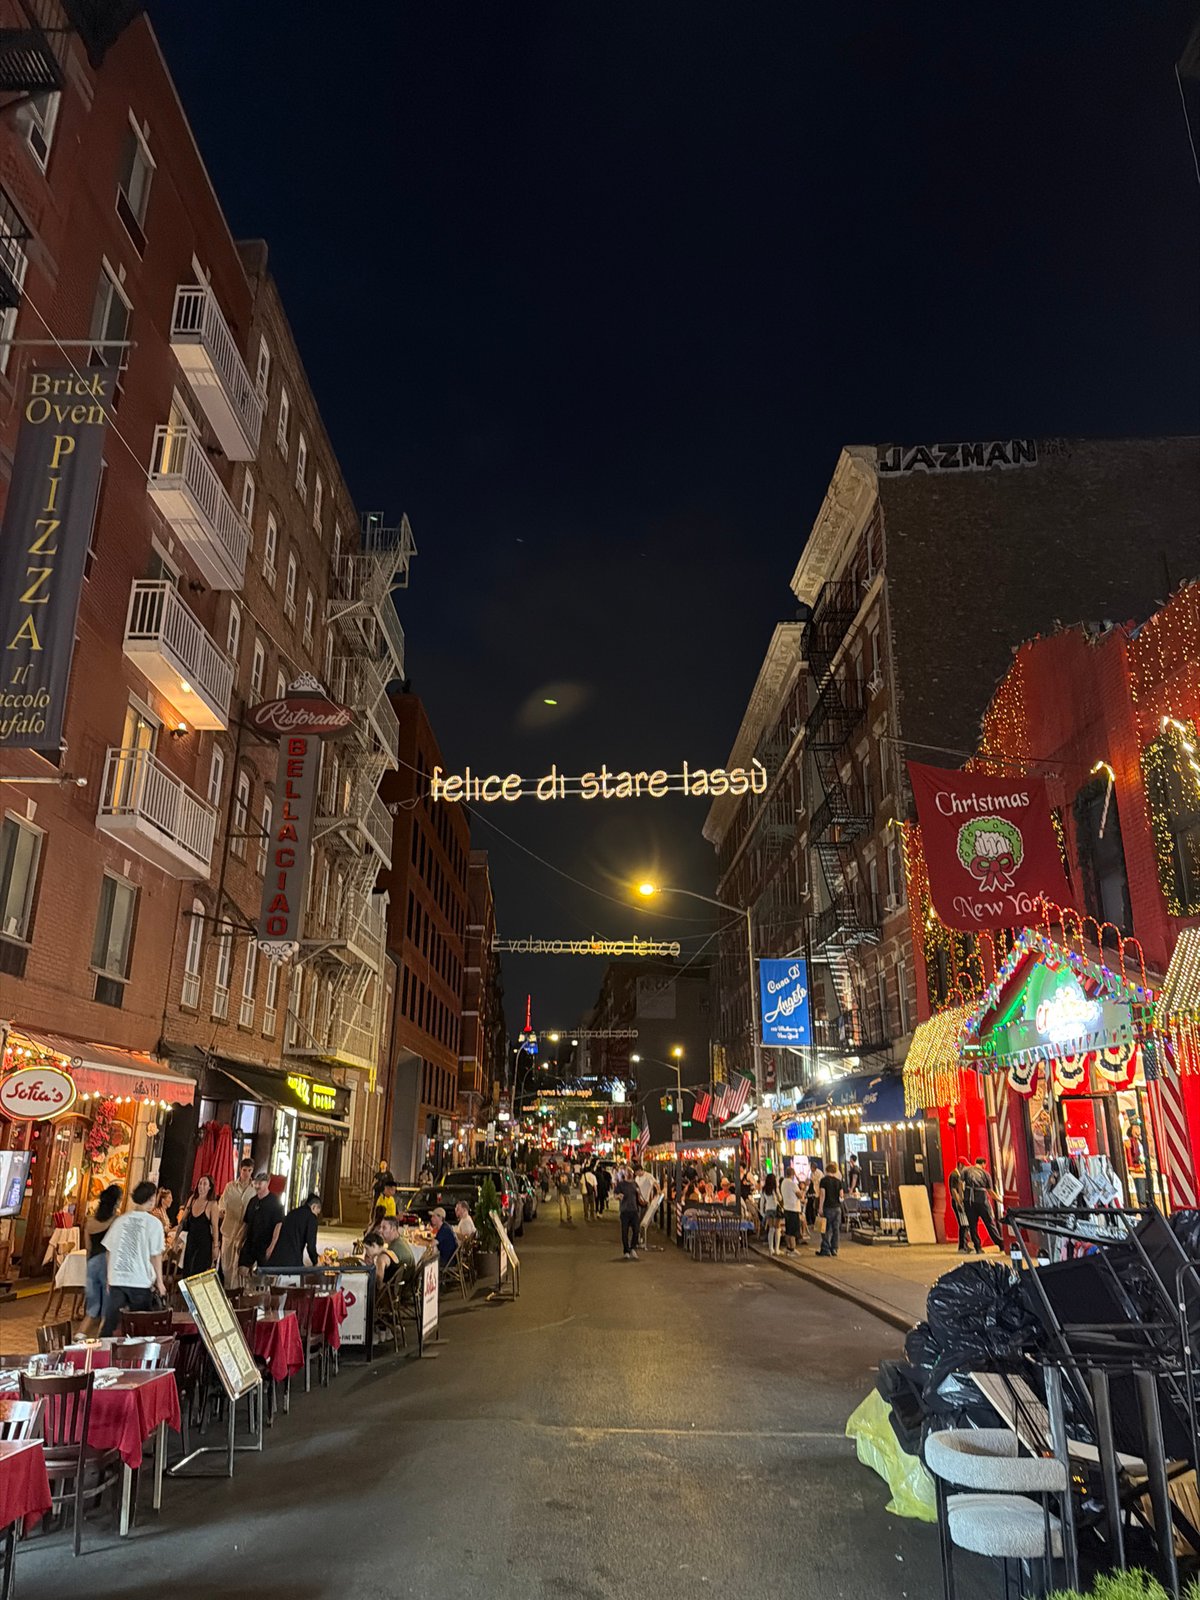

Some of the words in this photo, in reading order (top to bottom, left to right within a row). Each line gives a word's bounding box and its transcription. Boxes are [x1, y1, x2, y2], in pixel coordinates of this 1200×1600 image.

[31, 373, 107, 397] Brick
[25, 397, 105, 425] Oven
[879, 439, 1037, 476] JAZMAN
[6, 434, 76, 650] PIZZA
[0, 686, 50, 708] iccolo
[0, 712, 45, 740] ufalo
[255, 700, 350, 730] Ristorante
[431, 766, 522, 801] felice
[536, 764, 565, 800] di
[581, 764, 669, 799] stare
[683, 758, 767, 795] lassù
[935, 791, 1030, 816] Christmas
[953, 895, 1003, 922] New
[508, 934, 563, 954] volavo
[570, 935, 625, 956] volavo
[767, 977, 790, 994] Casa
[6, 1081, 63, 1103] Sofia's
